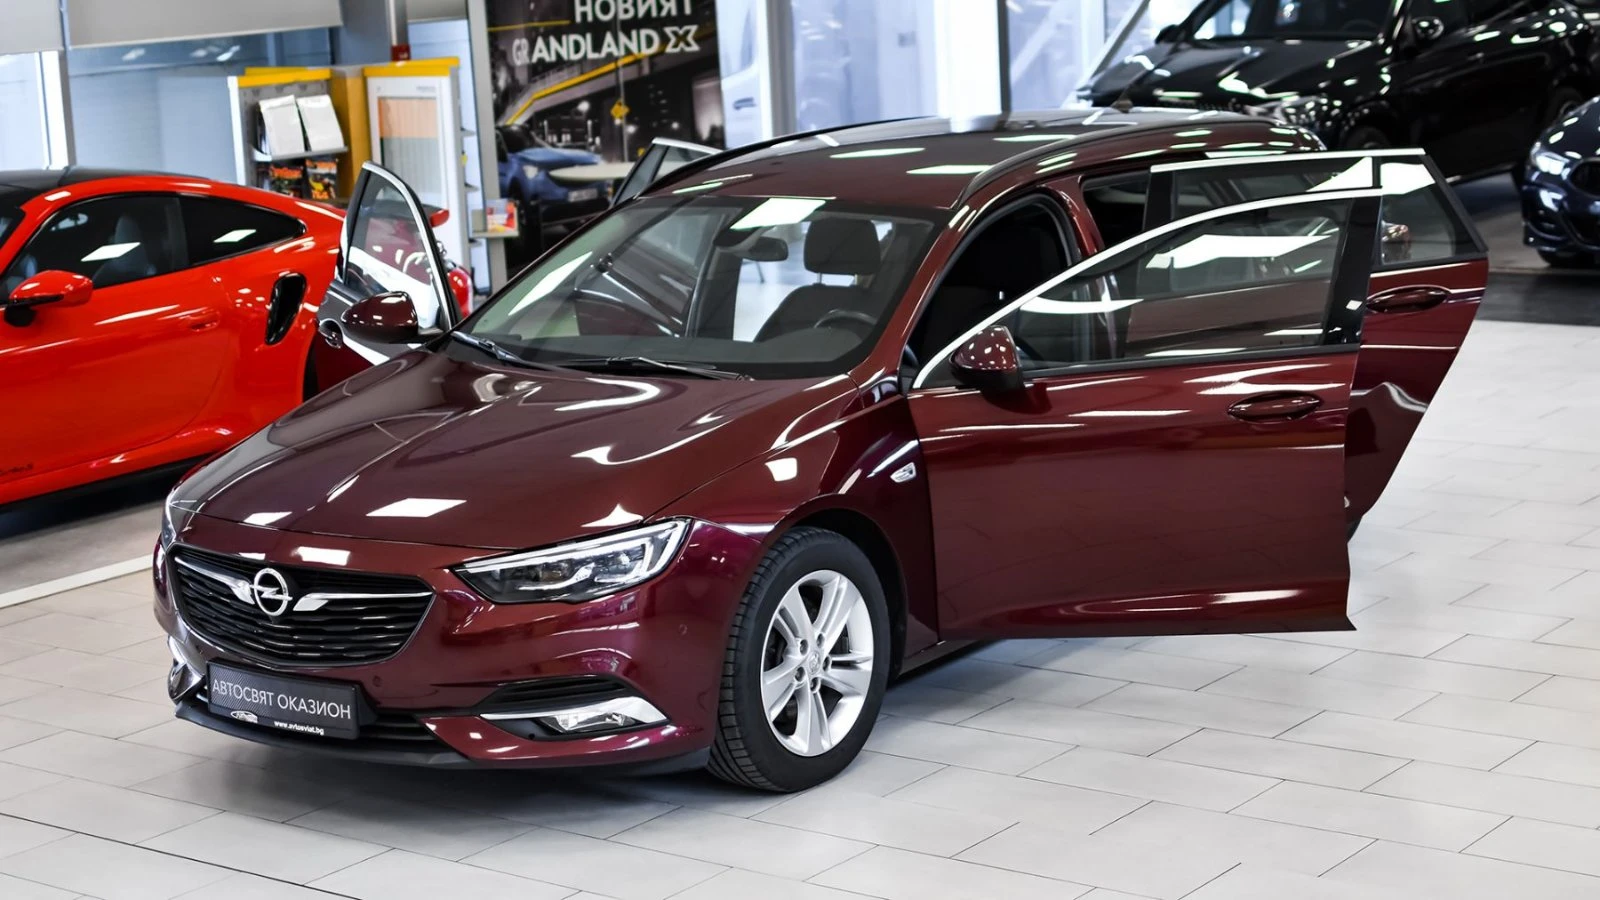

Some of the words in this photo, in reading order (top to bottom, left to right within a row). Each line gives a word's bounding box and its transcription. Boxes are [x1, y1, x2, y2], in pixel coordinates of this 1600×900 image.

[512, 28, 661, 66] GRANDLAND
[663, 25, 700, 53] X
[212, 679, 274, 706] АВТОСВЯТ
[277, 694, 351, 719] ОКАЗИОН
[274, 721, 325, 736] www.avtosviat.bg
